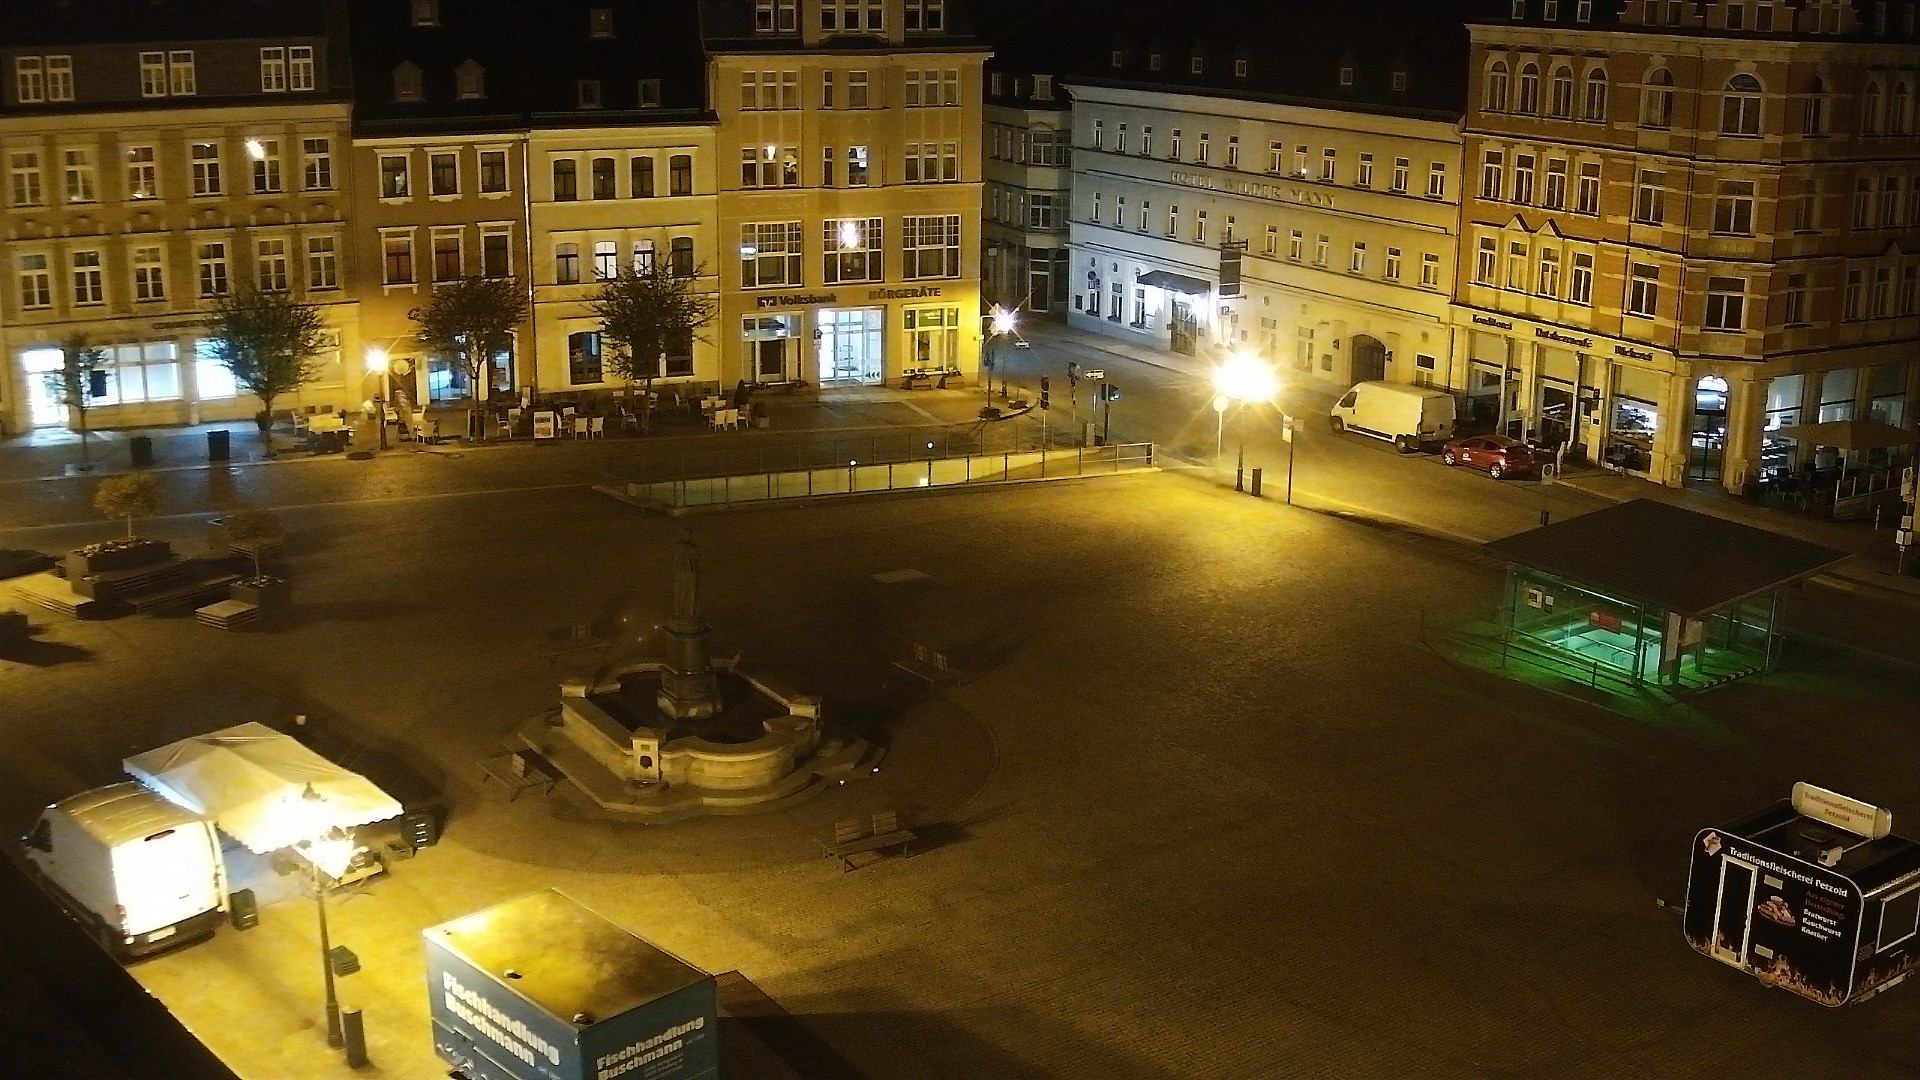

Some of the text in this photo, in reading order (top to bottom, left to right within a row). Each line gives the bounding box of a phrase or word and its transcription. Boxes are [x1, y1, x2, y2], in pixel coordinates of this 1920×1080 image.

[1170, 170, 1335, 209] HOTEL WILDER MANN
[778, 293, 837, 306] Volksbank
[868, 286, 941, 300] HÖRGERÄTE
[1804, 791, 1873, 820] Traditionsfleischerei
[1824, 808, 1850, 823] Petzold
[1729, 846, 1814, 885] Traditionsfleischerei
[1815, 879, 1848, 898] Petzold
[1803, 908, 1837, 926] Bratwurst
[442, 970, 560, 1066] Fischhandlung
[444, 991, 535, 1068] Buschmann
[596, 1016, 705, 1071] Fischhandlung
[597, 1038, 683, 1080] Buschmann
